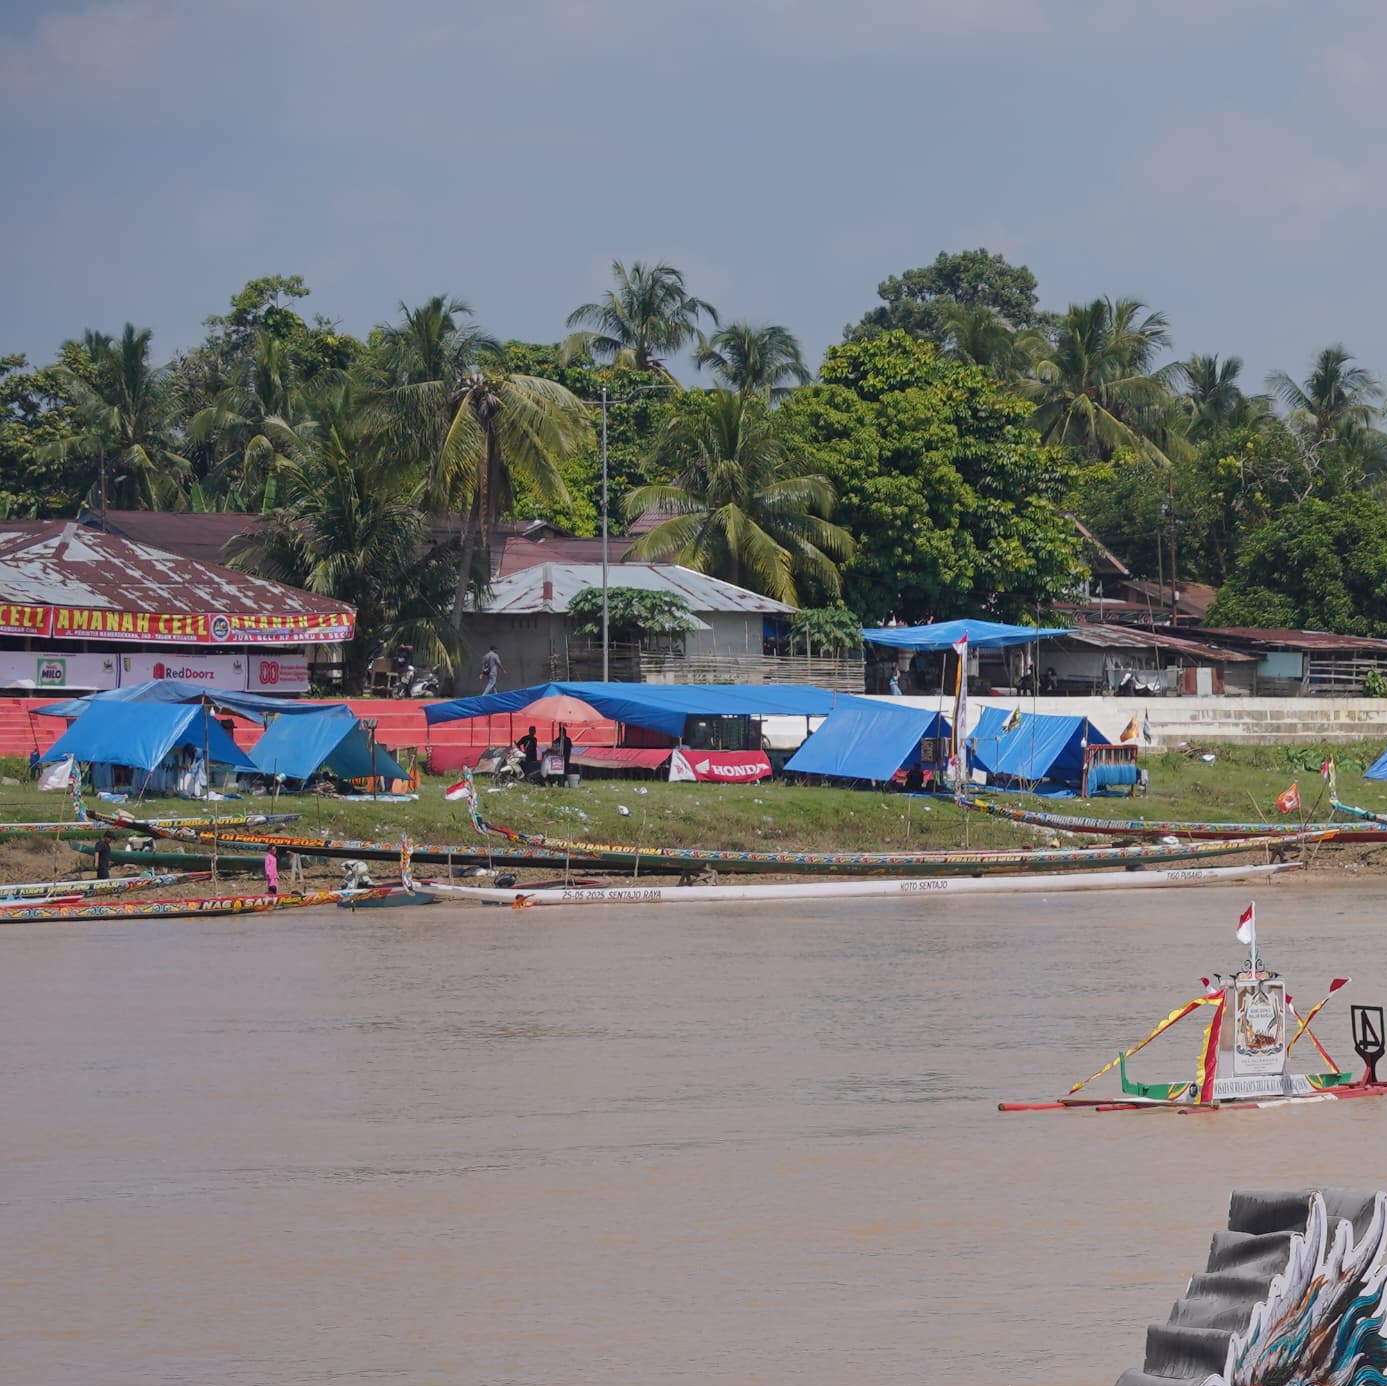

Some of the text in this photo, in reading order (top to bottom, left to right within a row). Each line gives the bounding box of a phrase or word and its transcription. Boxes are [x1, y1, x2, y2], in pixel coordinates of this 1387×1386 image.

[0, 605, 44, 628] CELL
[57, 609, 207, 635] AMANAH CELL
[231, 616, 308, 629] AMANAH
[41, 669, 62, 679] MILO
[166, 667, 215, 680] RedDoorz
[919, 880, 948, 891] SENTAJO
[608, 890, 641, 900] SENTAJO
[643, 890, 662, 899] RAYA
